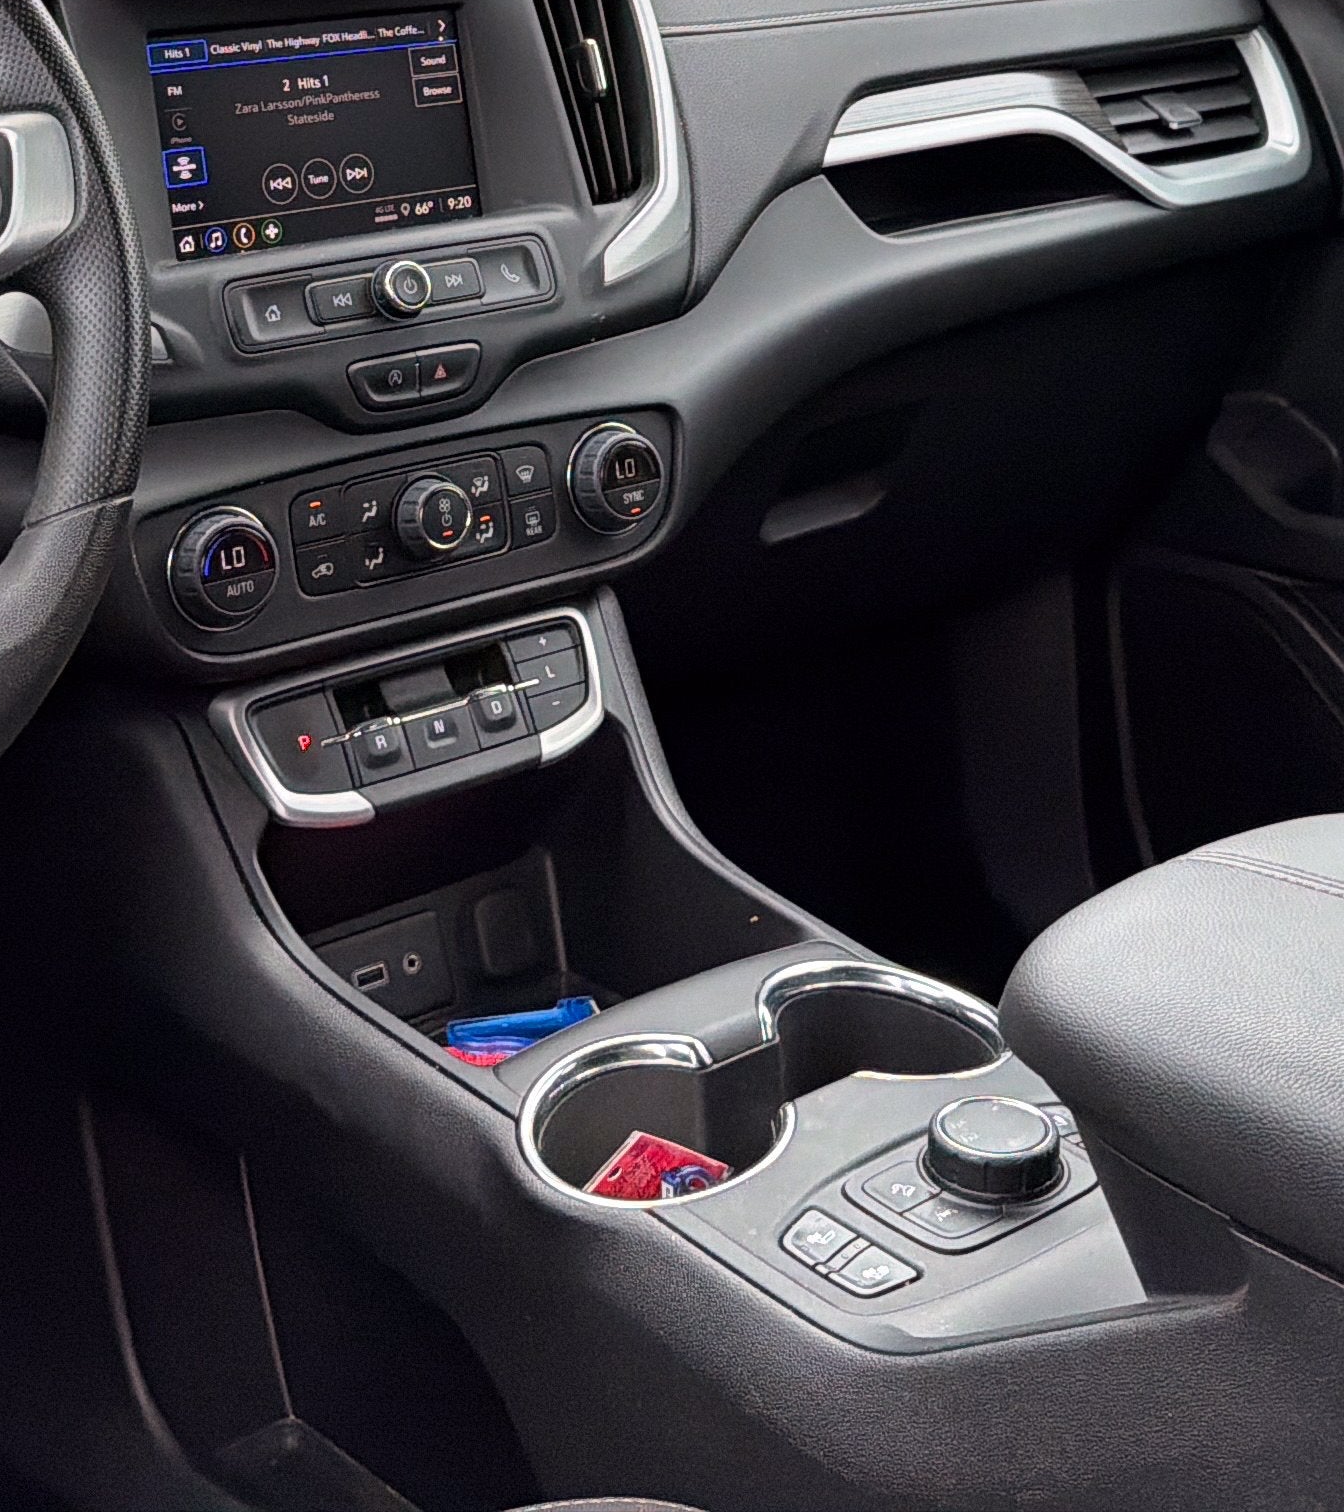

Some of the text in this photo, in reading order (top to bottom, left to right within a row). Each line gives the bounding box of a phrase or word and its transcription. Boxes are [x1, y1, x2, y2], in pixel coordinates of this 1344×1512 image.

[322, 33, 341, 44] FOX
[378, 28, 394, 37] The
[210, 40, 263, 55] Classic Vinyl
[266, 35, 320, 49] The Highway
[164, 48, 190, 59] Hits 1
[420, 55, 446, 66] Sound
[282, 75, 329, 91] 2 Hits 1
[167, 86, 183, 96] FM
[423, 87, 452, 97] Browse
[235, 102, 259, 115] Zara
[287, 110, 335, 126] Stateside
[307, 175, 329, 185] Tune
[172, 202, 196, 213] More
[448, 196, 472, 210] 9:20
[616, 458, 635, 480] LO
[622, 490, 645, 505] SYNC
[309, 513, 326, 527] A/C
[526, 526, 543, 536] REAR
[220, 546, 246, 570] LO
[227, 580, 255, 597] AUTO
[545, 665, 555, 679] L
[491, 700, 503, 716] D
[434, 719, 445, 735] N
[297, 735, 312, 752] P
[376, 735, 387, 749] R
